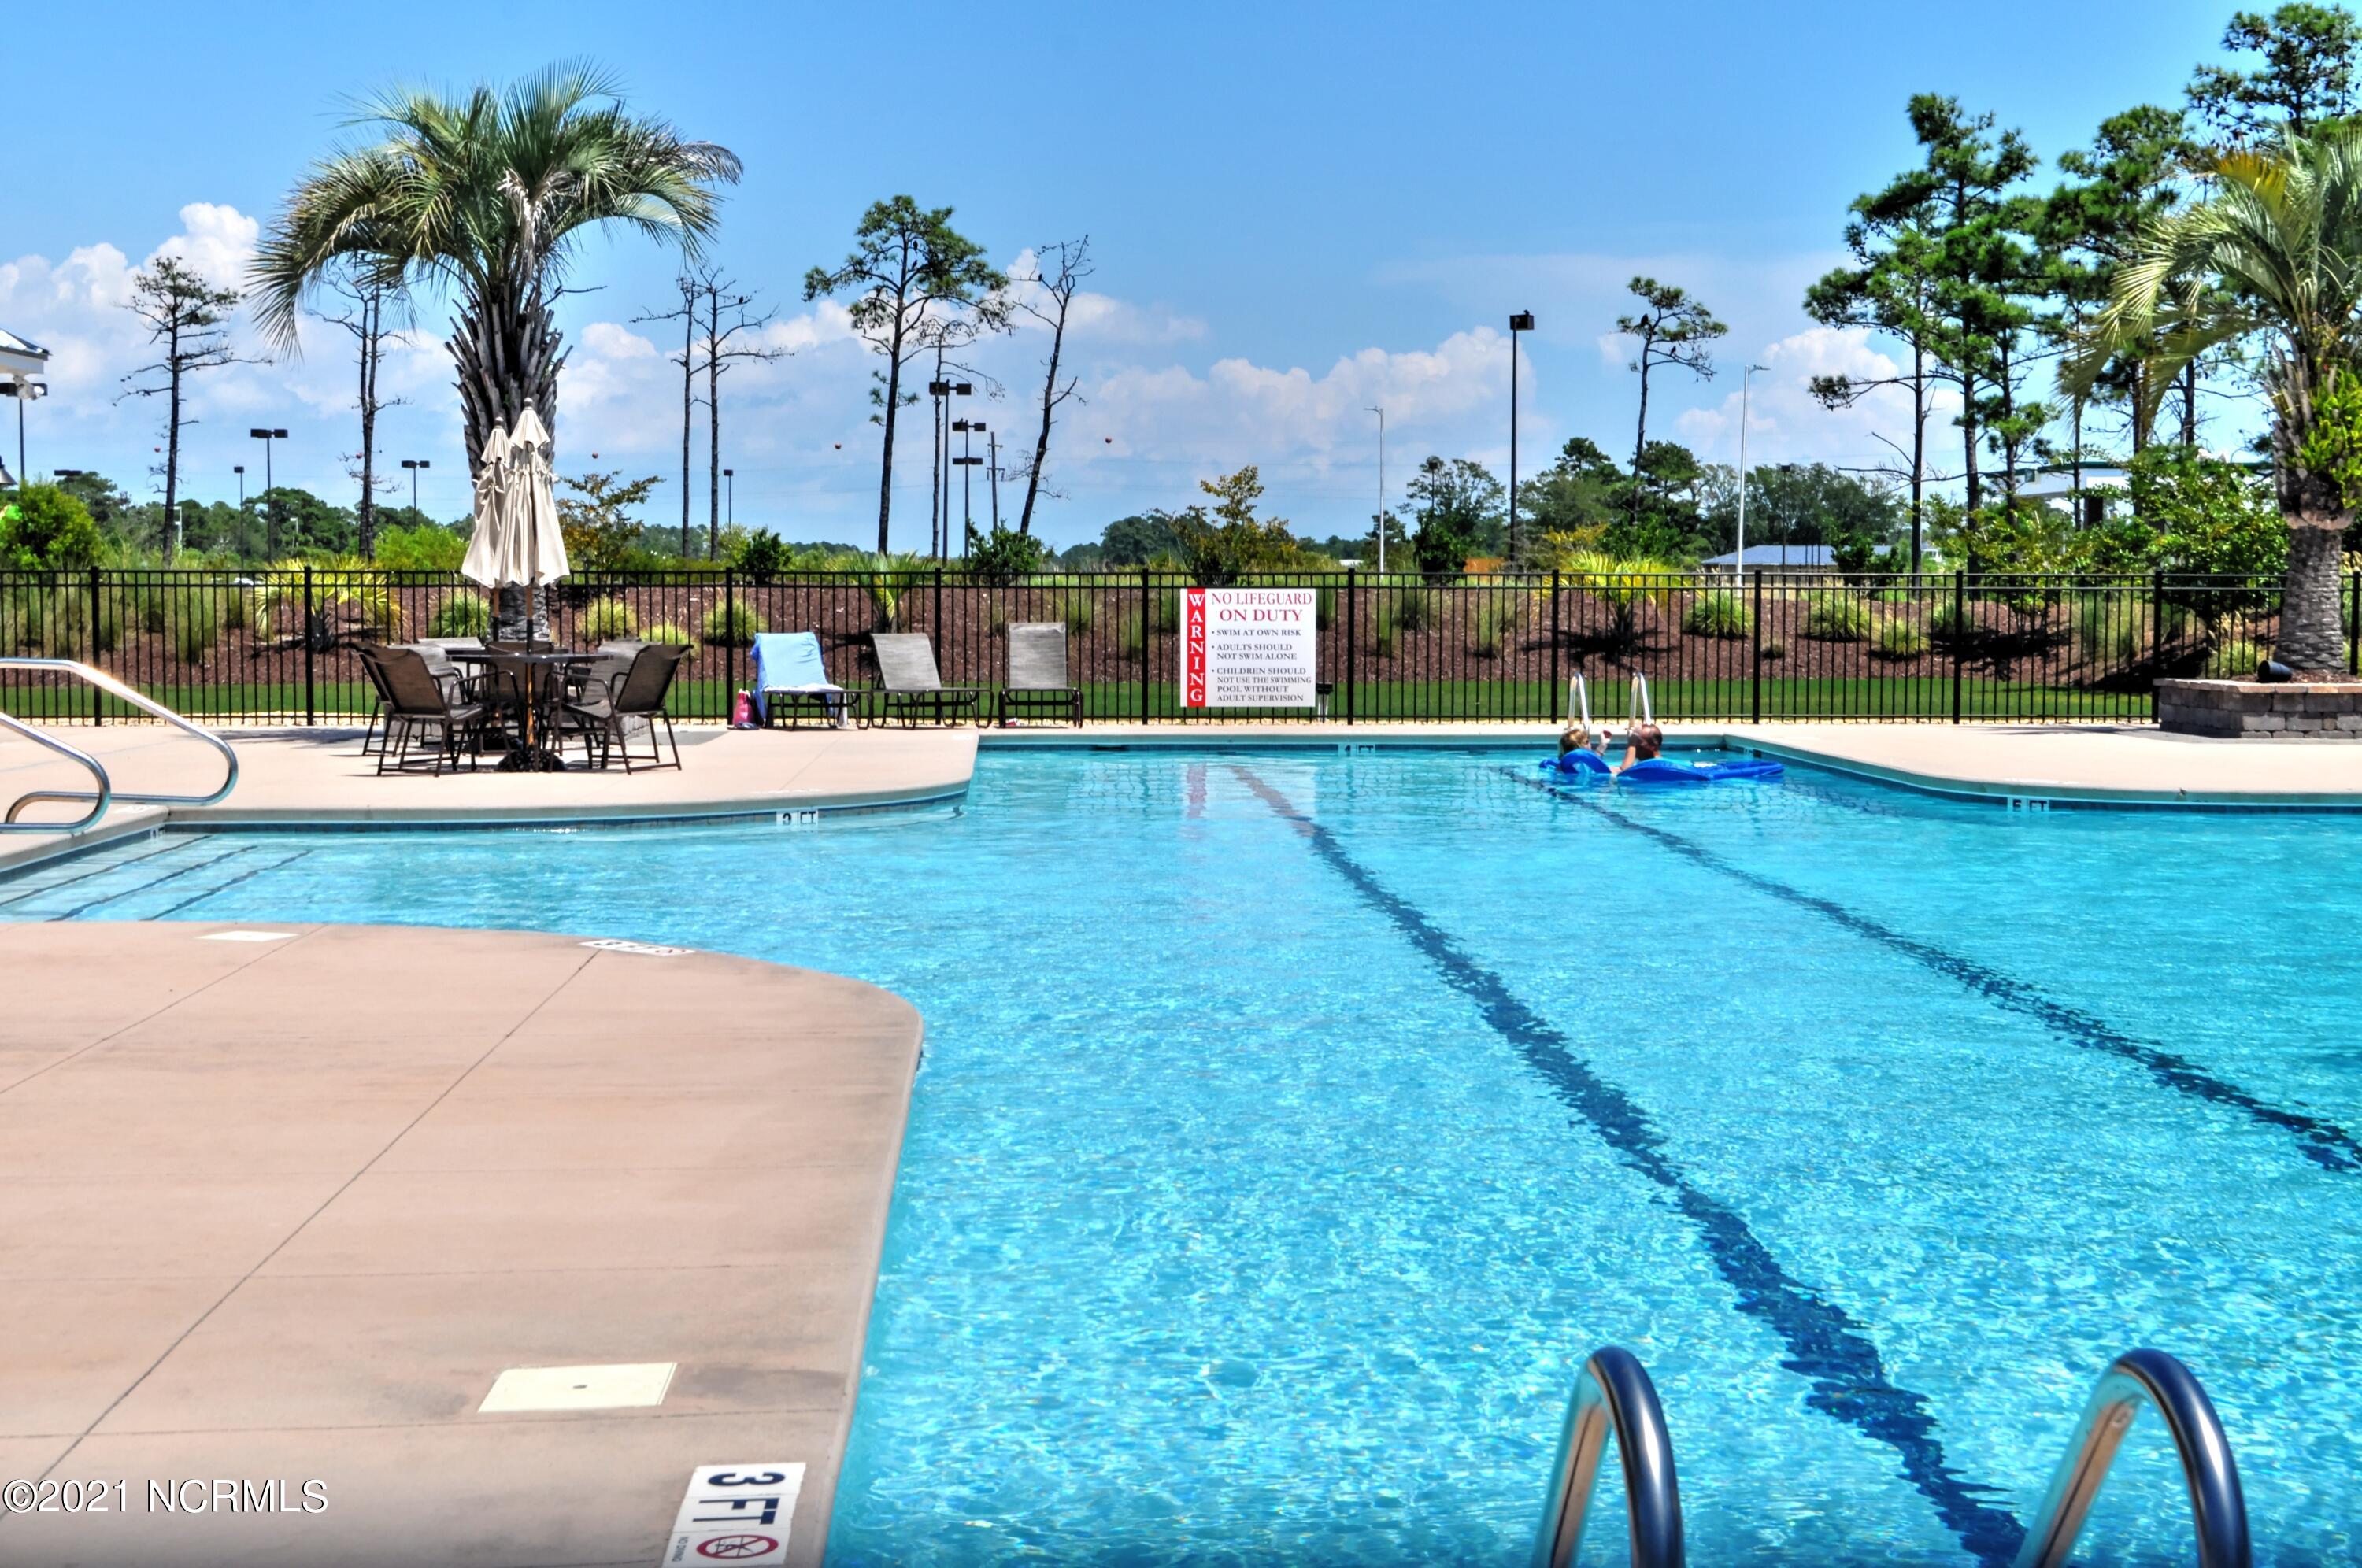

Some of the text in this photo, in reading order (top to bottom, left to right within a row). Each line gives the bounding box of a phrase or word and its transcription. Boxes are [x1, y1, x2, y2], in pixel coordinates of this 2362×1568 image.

[1212, 593, 1312, 605] NO LIFEGUARD
[1220, 609, 1303, 621] ON DUTY
[1188, 594, 1205, 701] WARNING
[800, 811, 816, 824] FT
[707, 1472, 786, 1486] 3
[692, 1497, 780, 1525] FT
